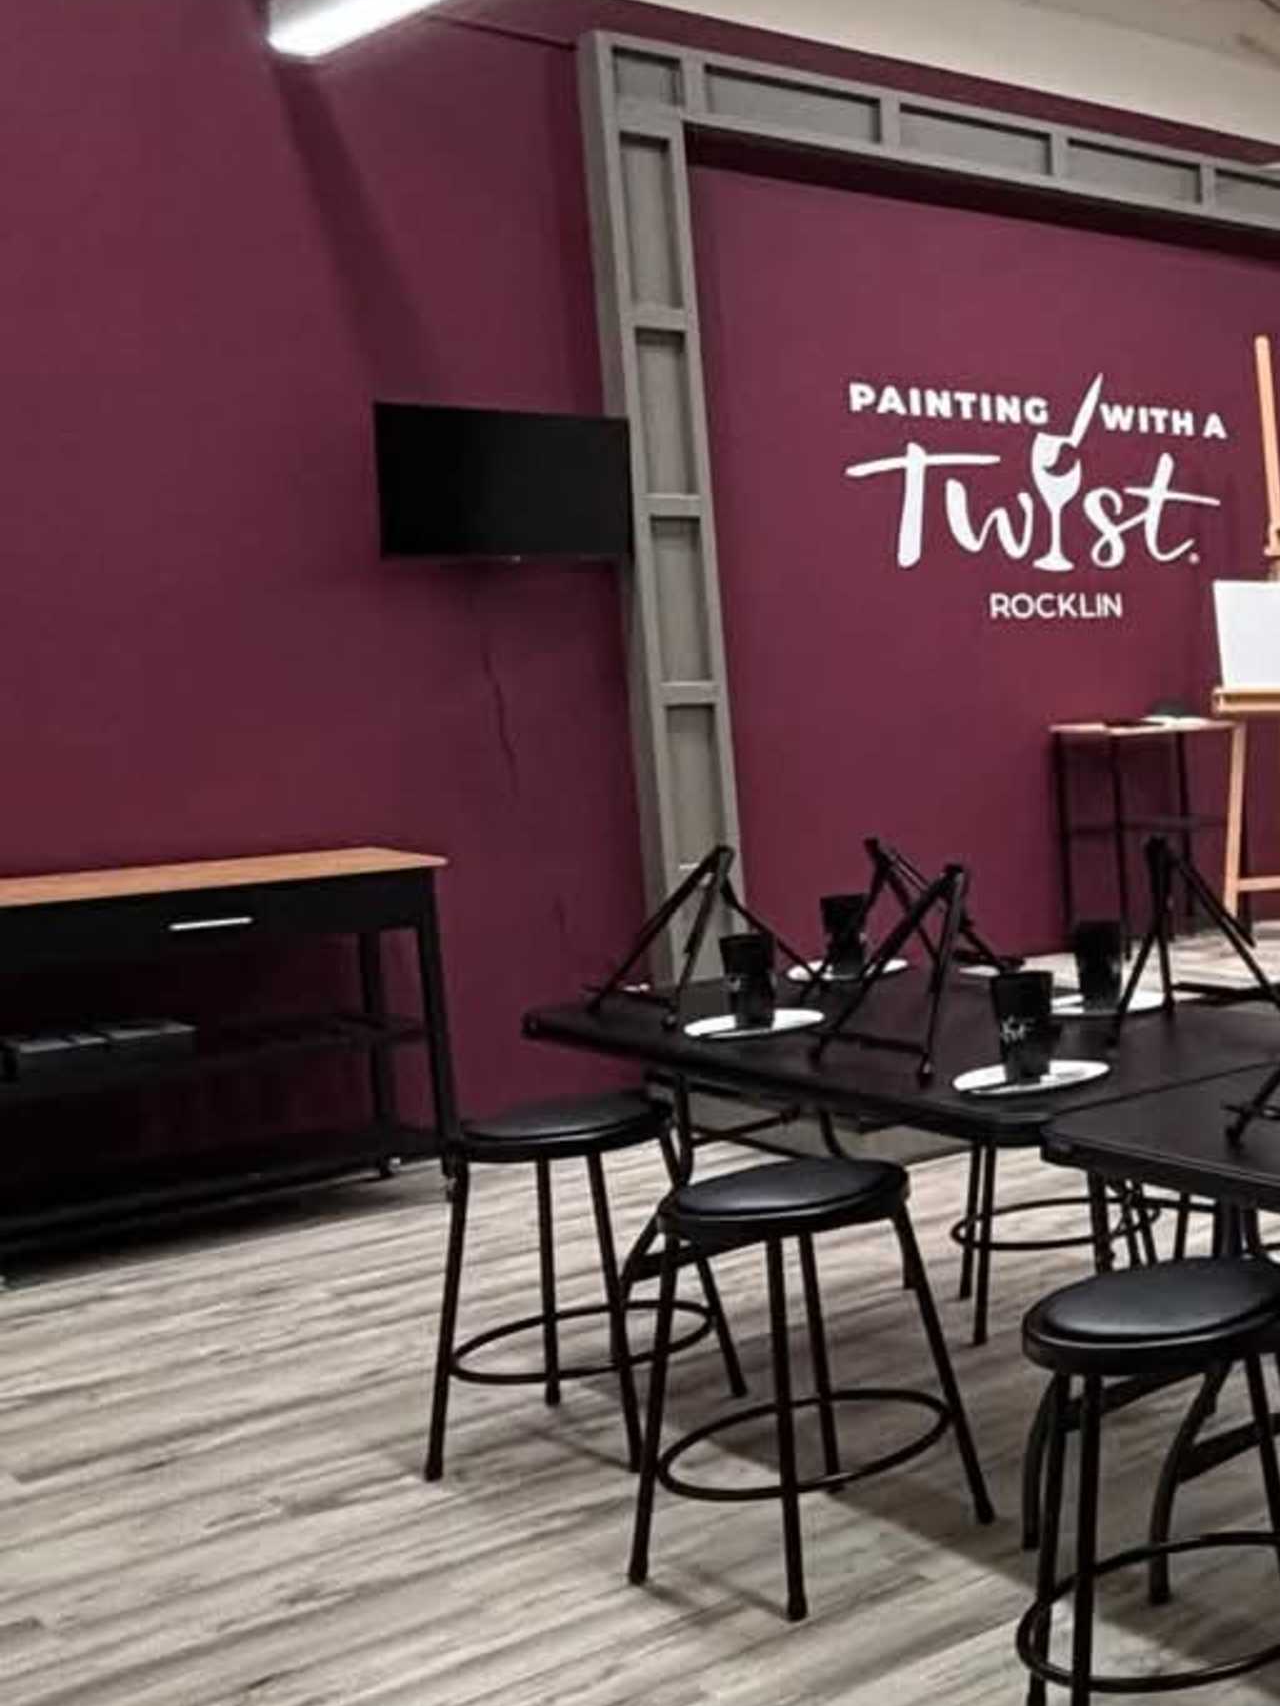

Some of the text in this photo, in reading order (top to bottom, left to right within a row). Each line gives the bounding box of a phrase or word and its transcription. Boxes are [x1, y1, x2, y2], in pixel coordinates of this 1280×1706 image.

[849, 382, 1227, 439] PAINTING WITH A
[989, 592, 1122, 619] ROCKLIN
